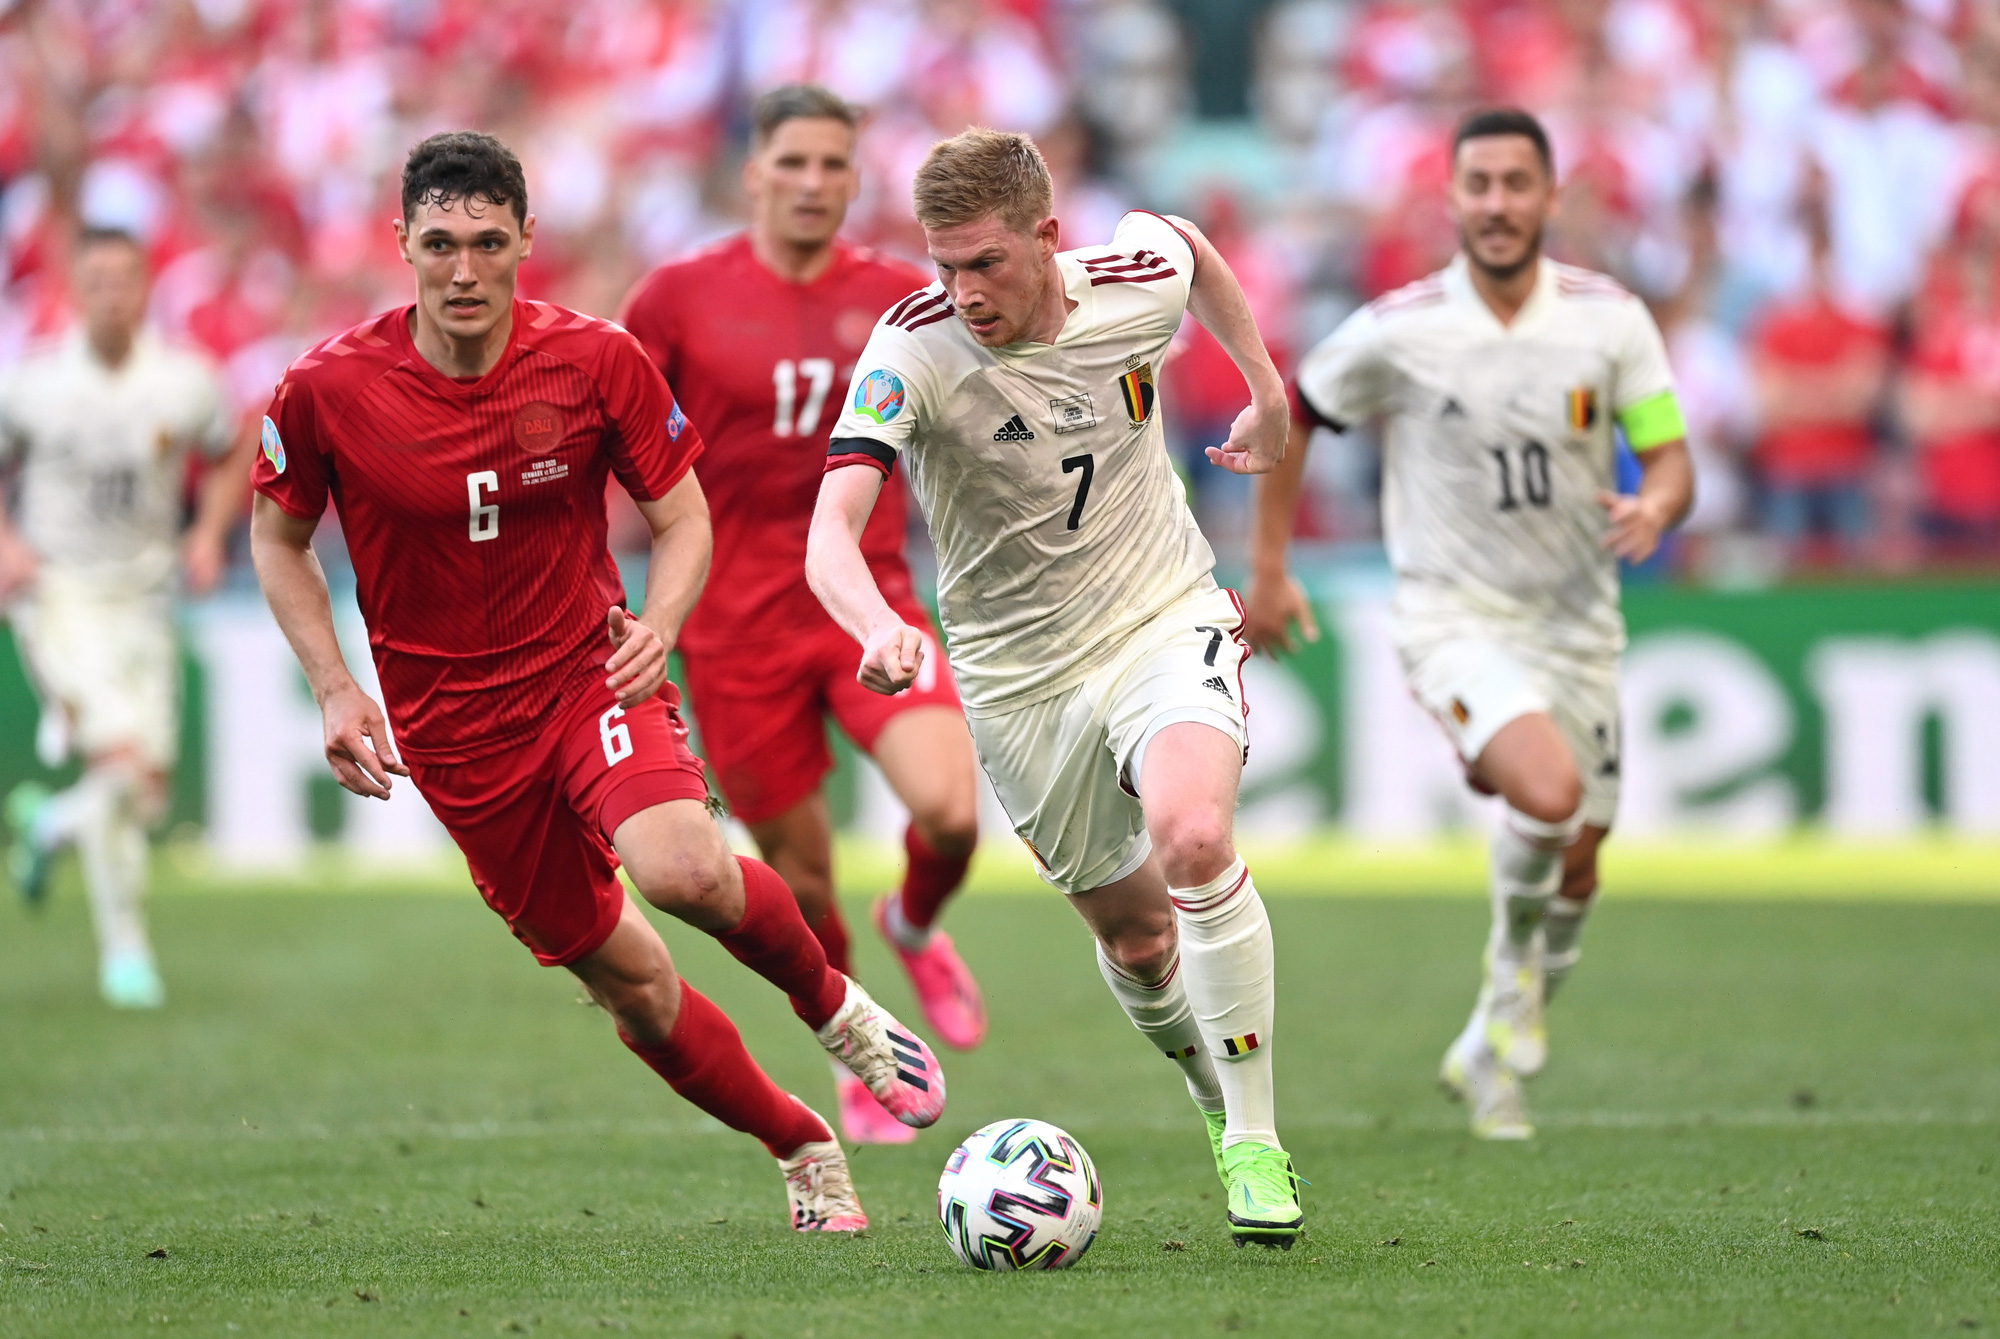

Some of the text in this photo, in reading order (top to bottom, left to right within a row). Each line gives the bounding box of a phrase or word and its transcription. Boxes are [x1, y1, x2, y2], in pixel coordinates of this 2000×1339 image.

[772, 358, 834, 437] 17
[525, 419, 552, 434] DBU
[993, 431, 1034, 441] adidas
[521, 470, 543, 480] DENMARK
[549, 464, 568, 474] BELGIUM
[532, 459, 557, 470] EURO 2020
[1490, 437, 1552, 511] 10
[466, 470, 499, 542] 6
[1062, 454, 1094, 530] 7
[1195, 626, 1223, 667] 7
[1202, 682, 1233, 701] adidas
[599, 702, 634, 767] 6
